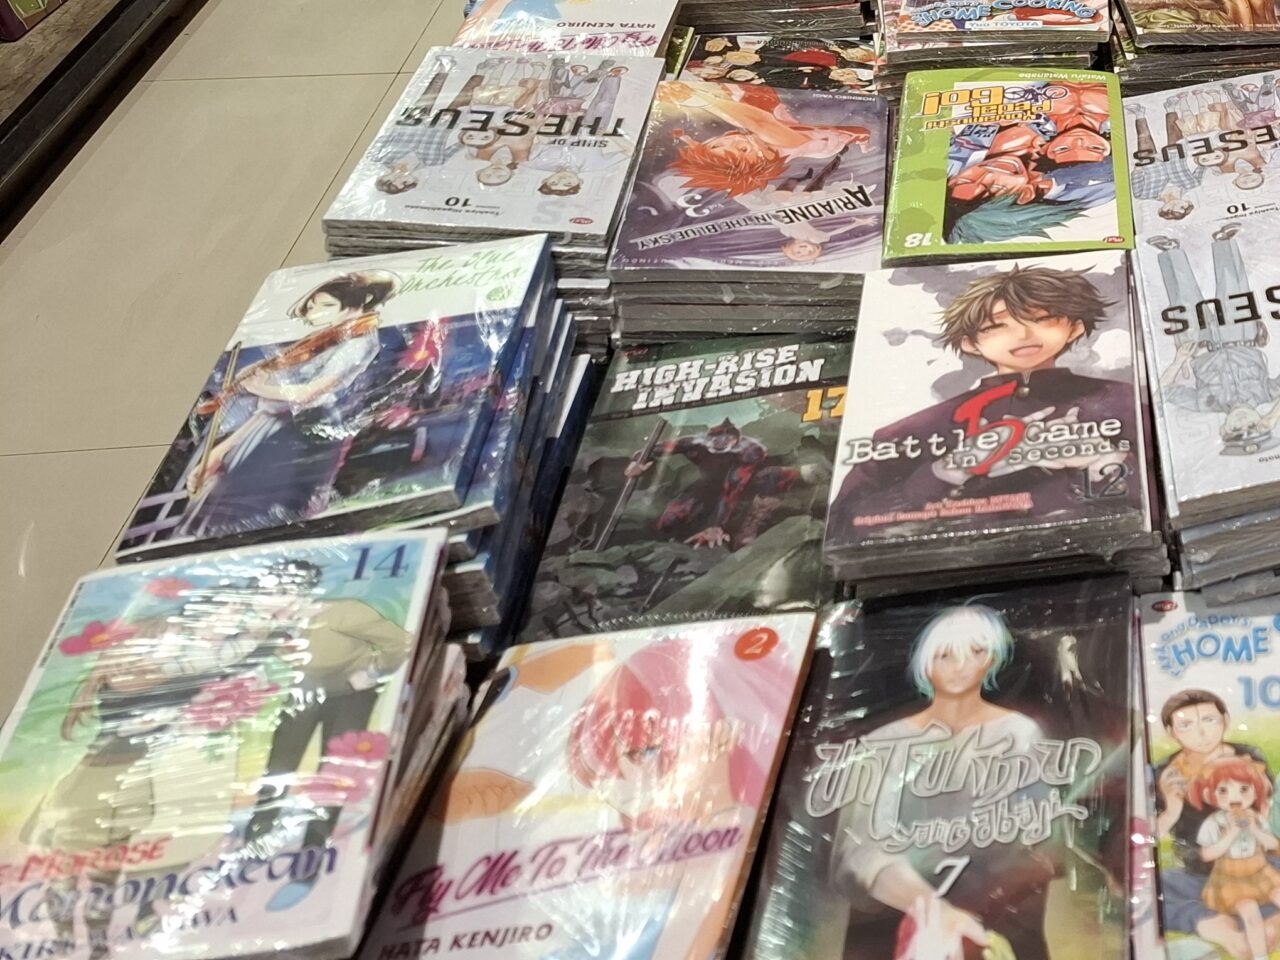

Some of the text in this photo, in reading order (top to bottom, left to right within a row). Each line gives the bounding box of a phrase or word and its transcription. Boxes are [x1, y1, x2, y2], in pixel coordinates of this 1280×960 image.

[556, 21, 656, 30] KENJIRO HATA
[919, 4, 992, 27] HOME
[1071, 73, 1107, 81] Wataru
[399, 106, 626, 139] THESEUS
[548, 139, 568, 148] OF
[447, 197, 475, 208] 10
[630, 185, 873, 251] ARIADNE IN THE BLUE SKY
[685, 193, 709, 217] 3
[1226, 201, 1250, 216] 10
[904, 232, 932, 248] 18
[416, 253, 454, 275] The
[611, 344, 799, 393] HIGH-RISE
[632, 359, 825, 411] INVASION
[802, 386, 847, 424] 17
[844, 380, 1122, 477] Battle 5 Game
[943, 439, 1132, 470] in Seconds
[1080, 462, 1131, 501] 12
[344, 544, 410, 583] 14
[742, 632, 772, 656] 2
[1170, 625, 1271, 667] HOME
[391, 864, 455, 917] Fly
[455, 848, 527, 904] Me
[528, 838, 575, 883] To
[575, 830, 640, 881] The
[934, 855, 971, 898] 7
[449, 922, 555, 953] KENJIRO
